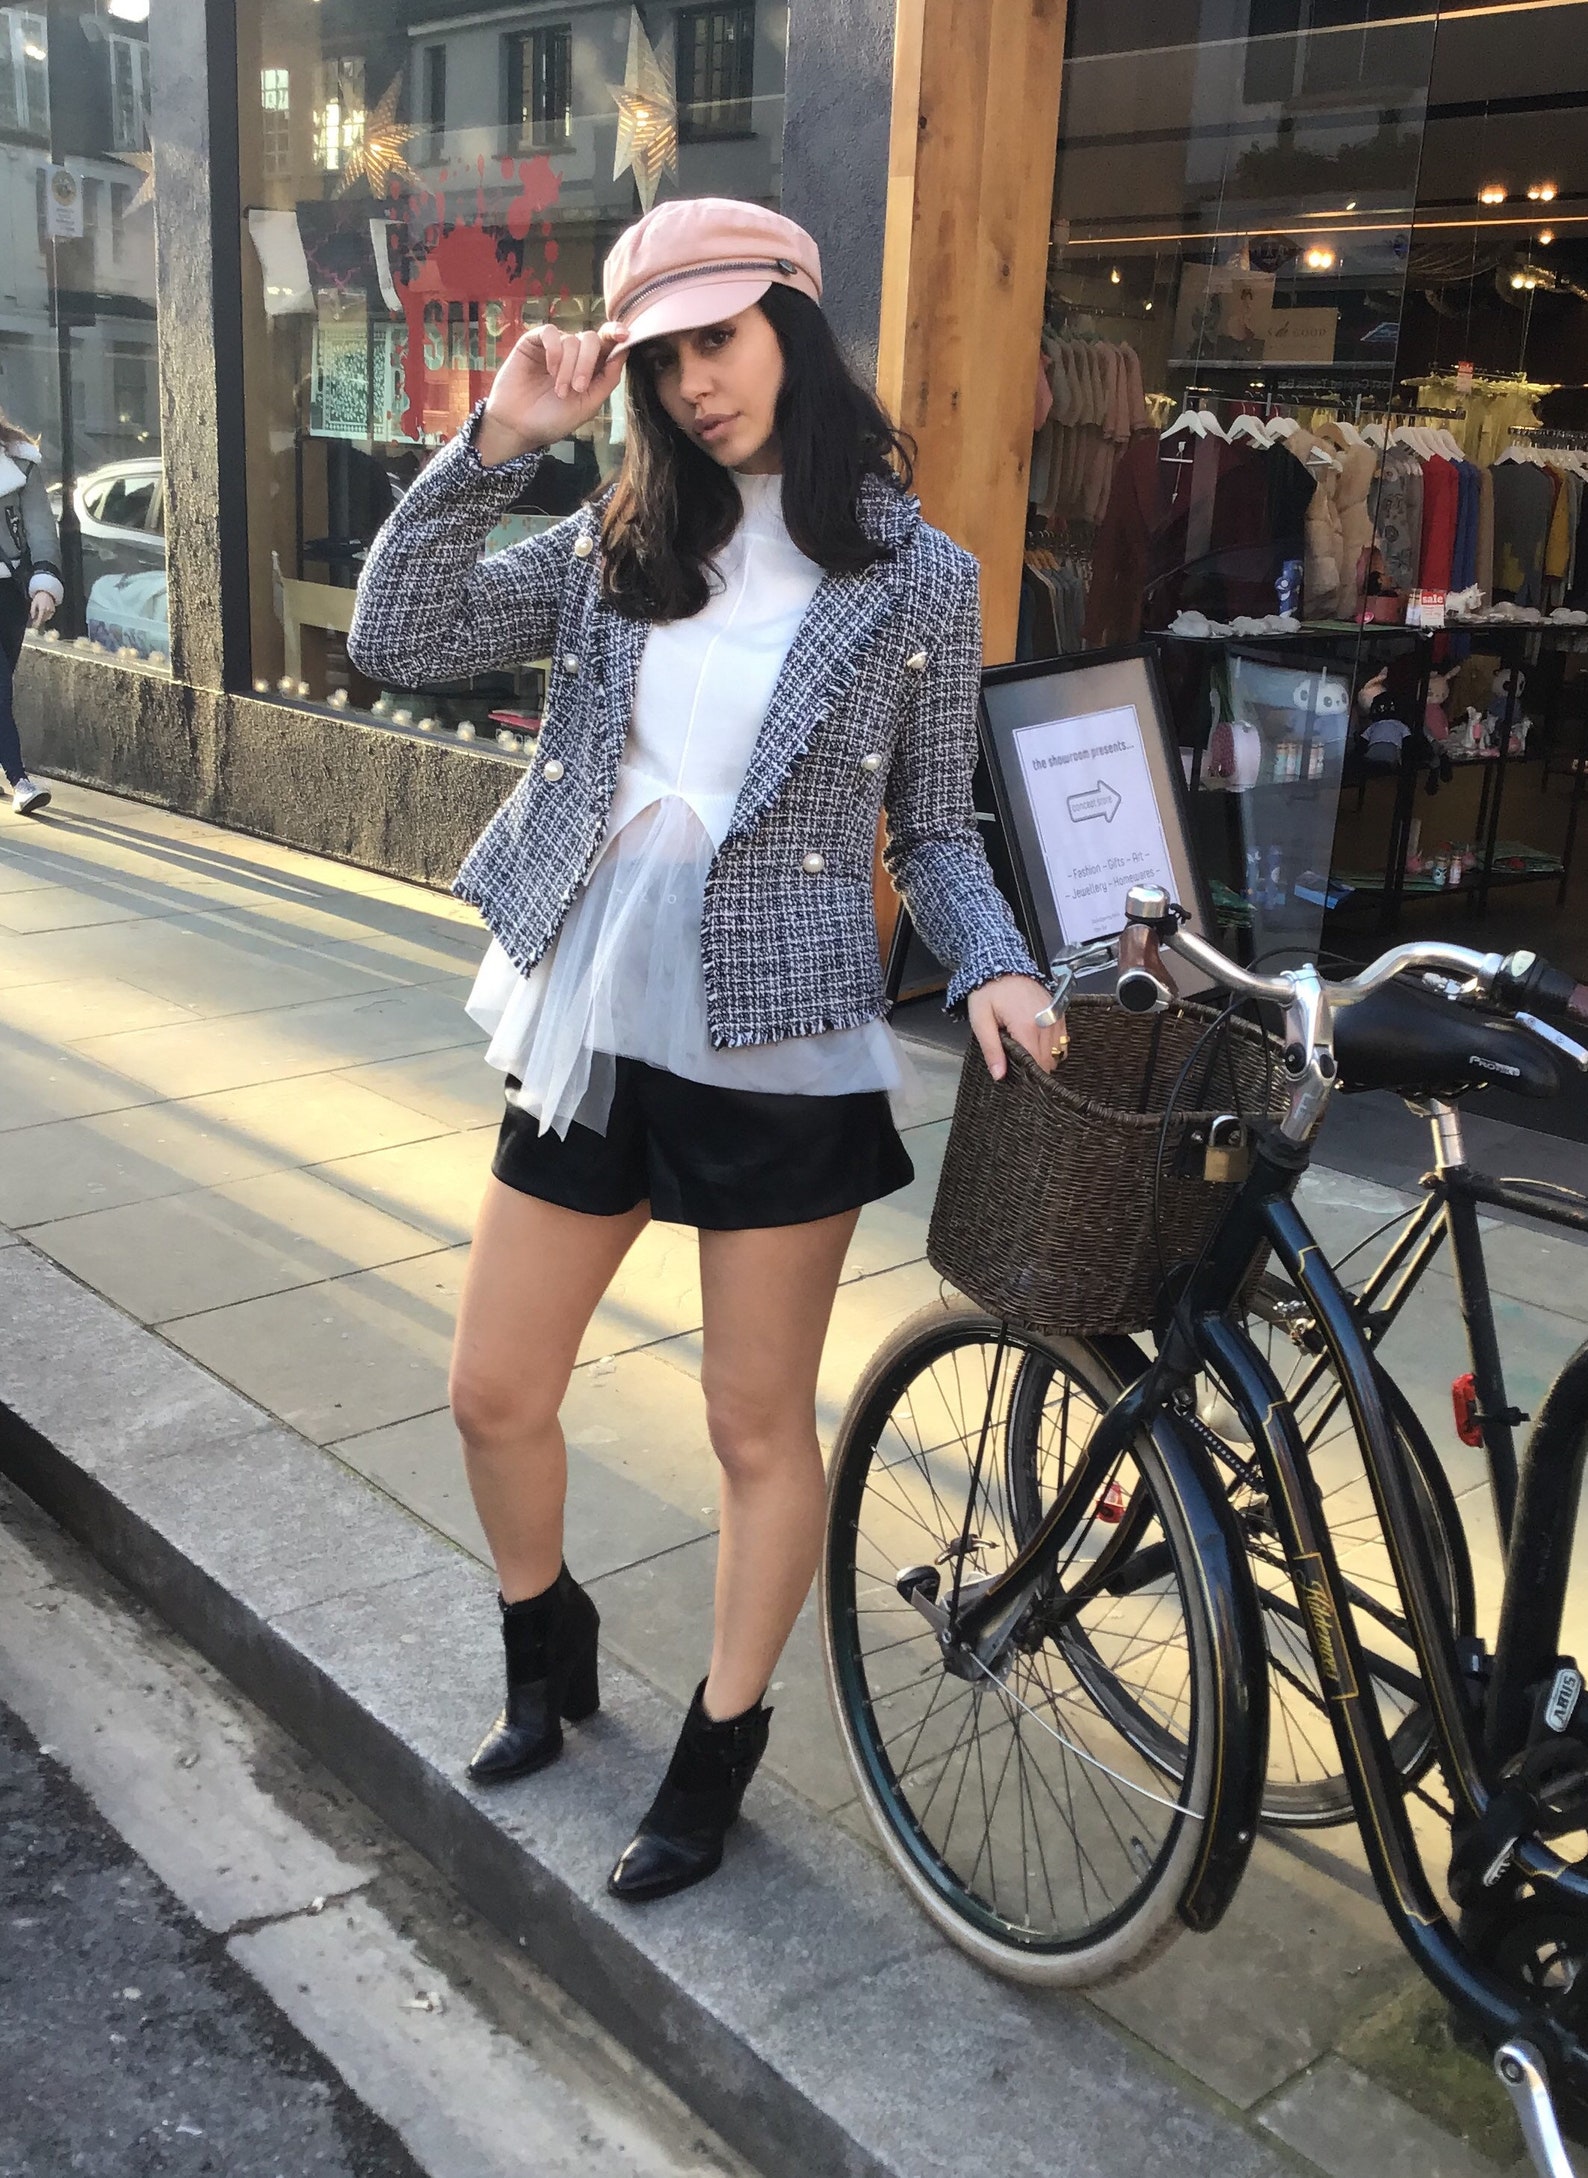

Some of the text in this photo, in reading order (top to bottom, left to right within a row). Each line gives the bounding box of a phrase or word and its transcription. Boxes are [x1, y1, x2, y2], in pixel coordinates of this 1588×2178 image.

[423, 300, 503, 371] SALE
[1422, 594, 1444, 604] sale
[1032, 740, 1135, 771] the showroom presents...
[1071, 799, 1096, 812] concept
[1073, 851, 1144, 879] Fashion Gifts Art
[1072, 868, 1155, 900] Jewellery Homewares
[1553, 1675, 1577, 1724] ABUS
